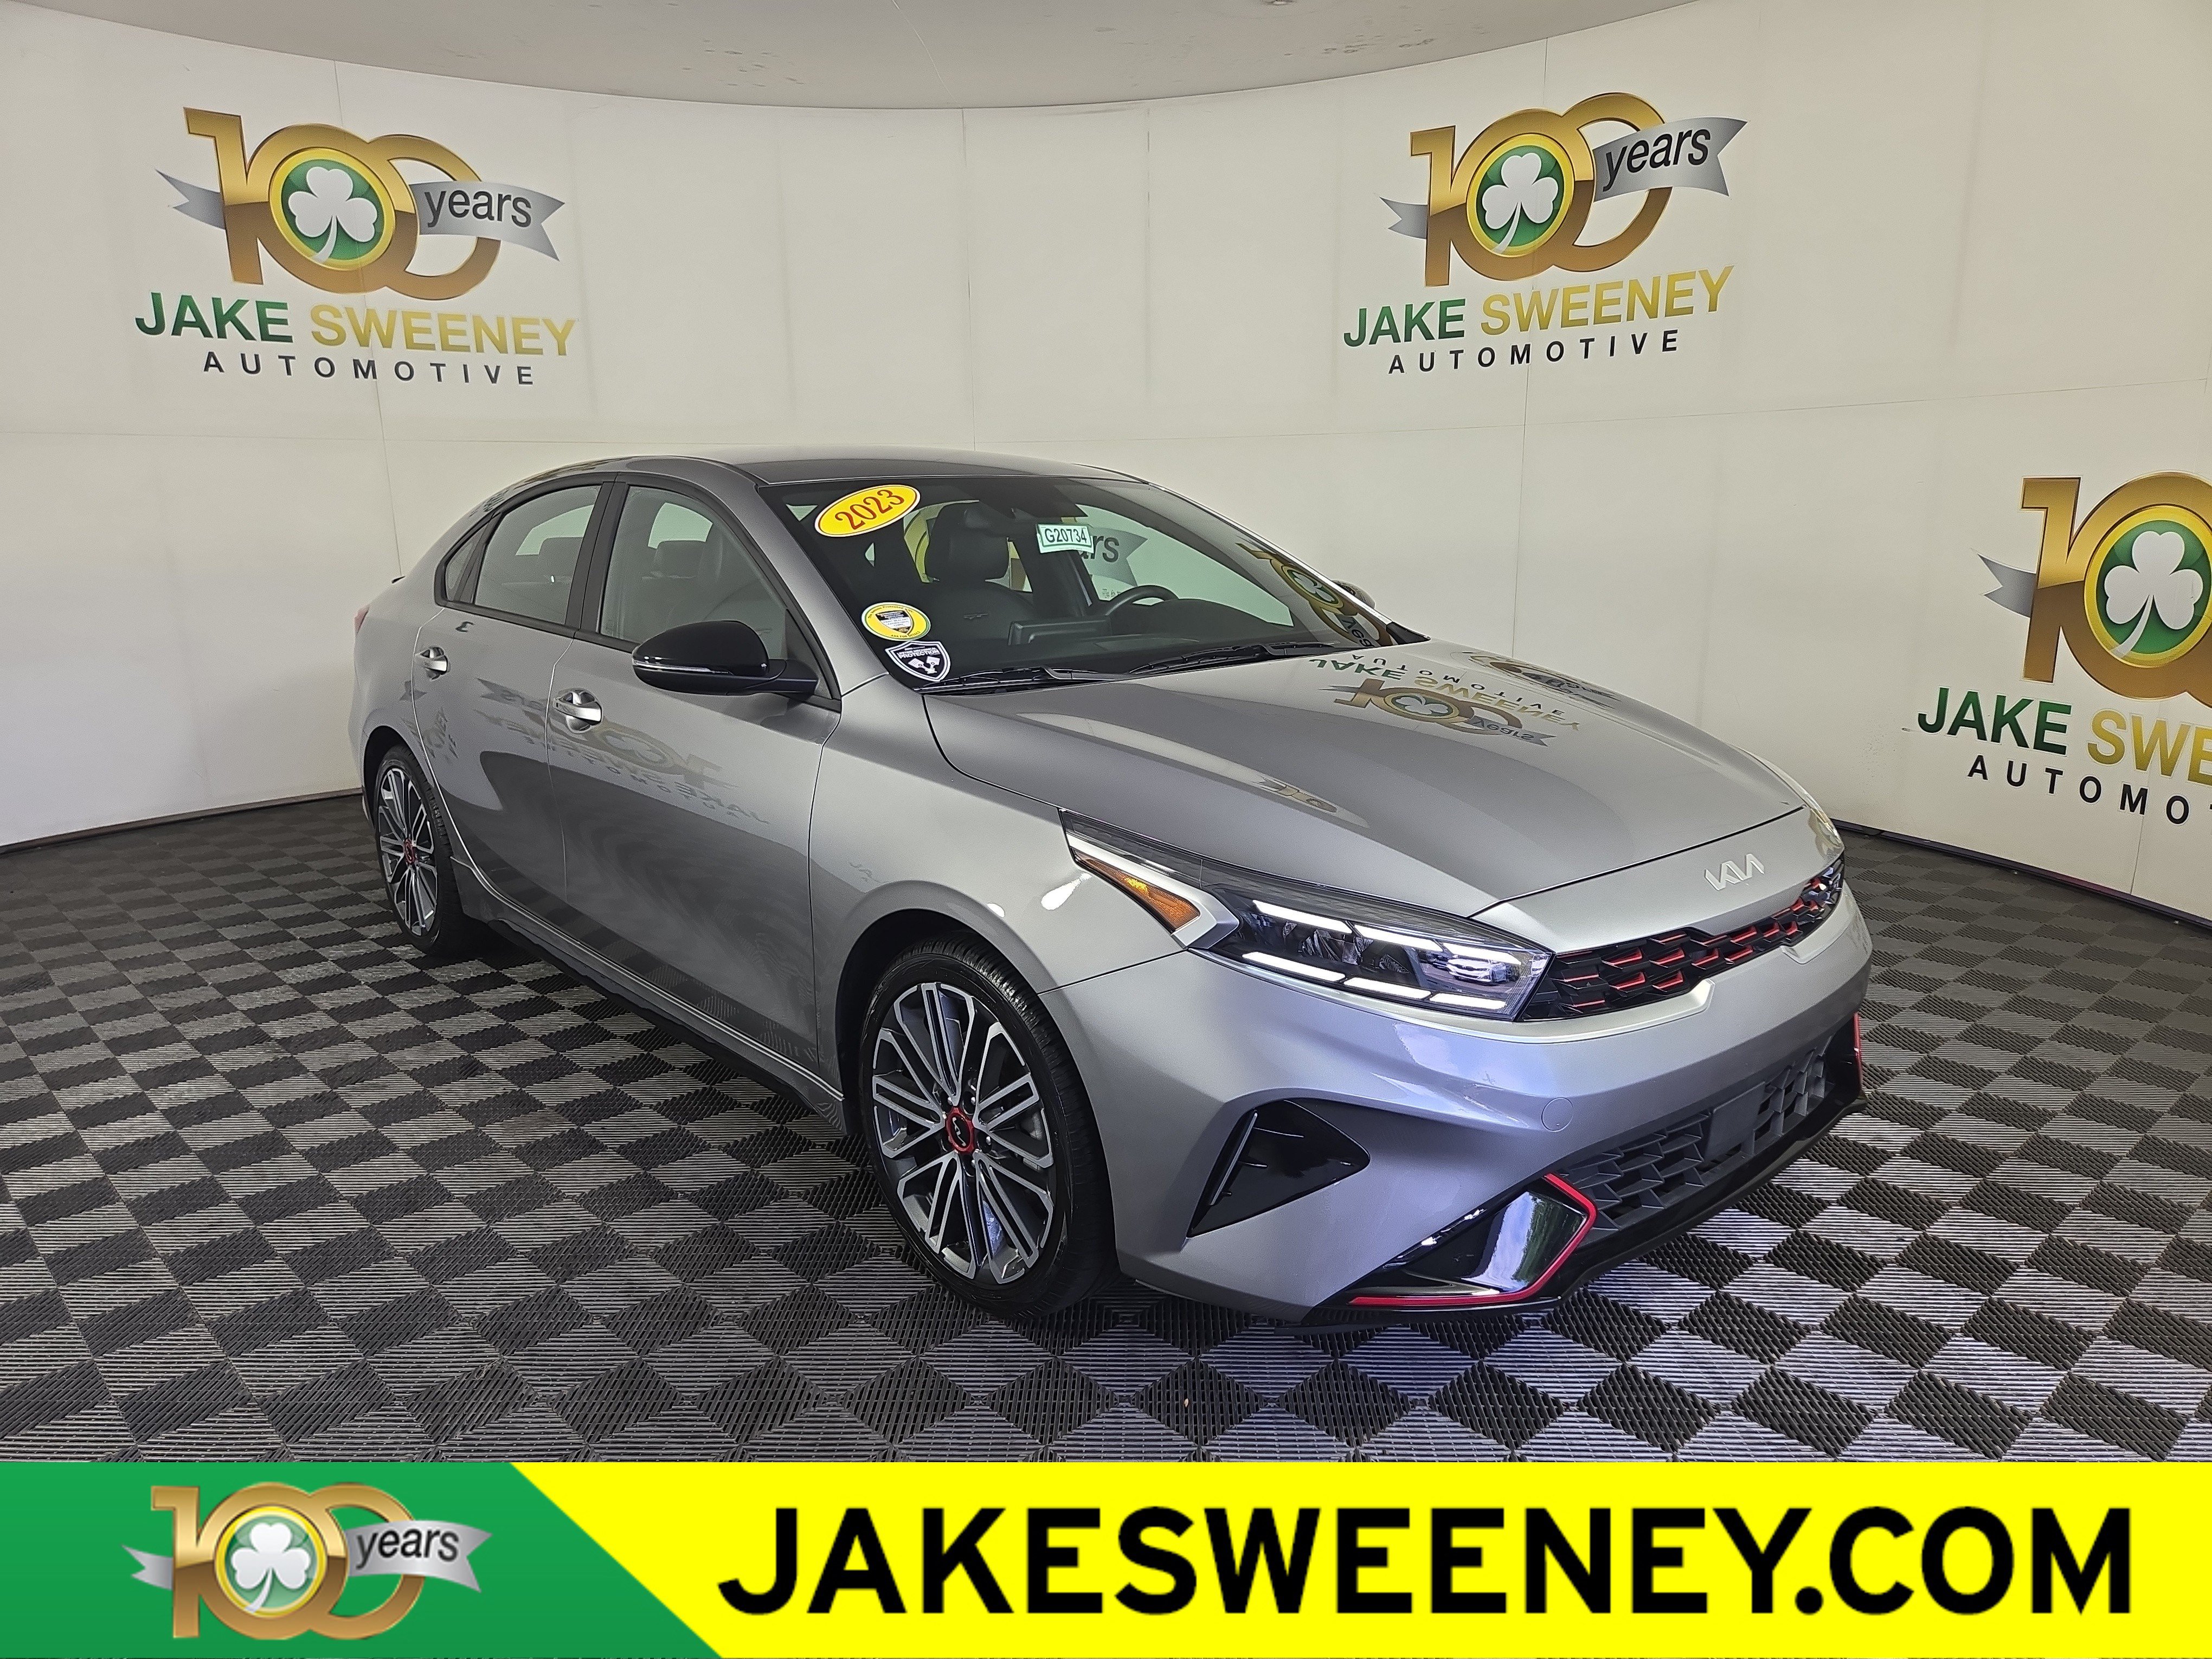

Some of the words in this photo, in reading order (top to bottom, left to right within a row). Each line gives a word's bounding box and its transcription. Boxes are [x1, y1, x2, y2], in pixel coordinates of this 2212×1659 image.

[1603, 128, 1712, 191] years
[424, 189, 532, 228] years
[135, 292, 293, 343] JAKE
[310, 305, 576, 356] SWEENEY
[1344, 299, 1466, 347] JAKE
[1481, 266, 1734, 336] SWEENEY
[203, 351, 533, 385] AUTOMOTIVE
[1388, 330, 1679, 374] AUTOMOTIVE
[835, 490, 904, 530] 2023
[1045, 528, 1086, 543] G20734
[1918, 687, 2072, 755] JAKE
[1968, 755, 2212, 824] AUTOMO
